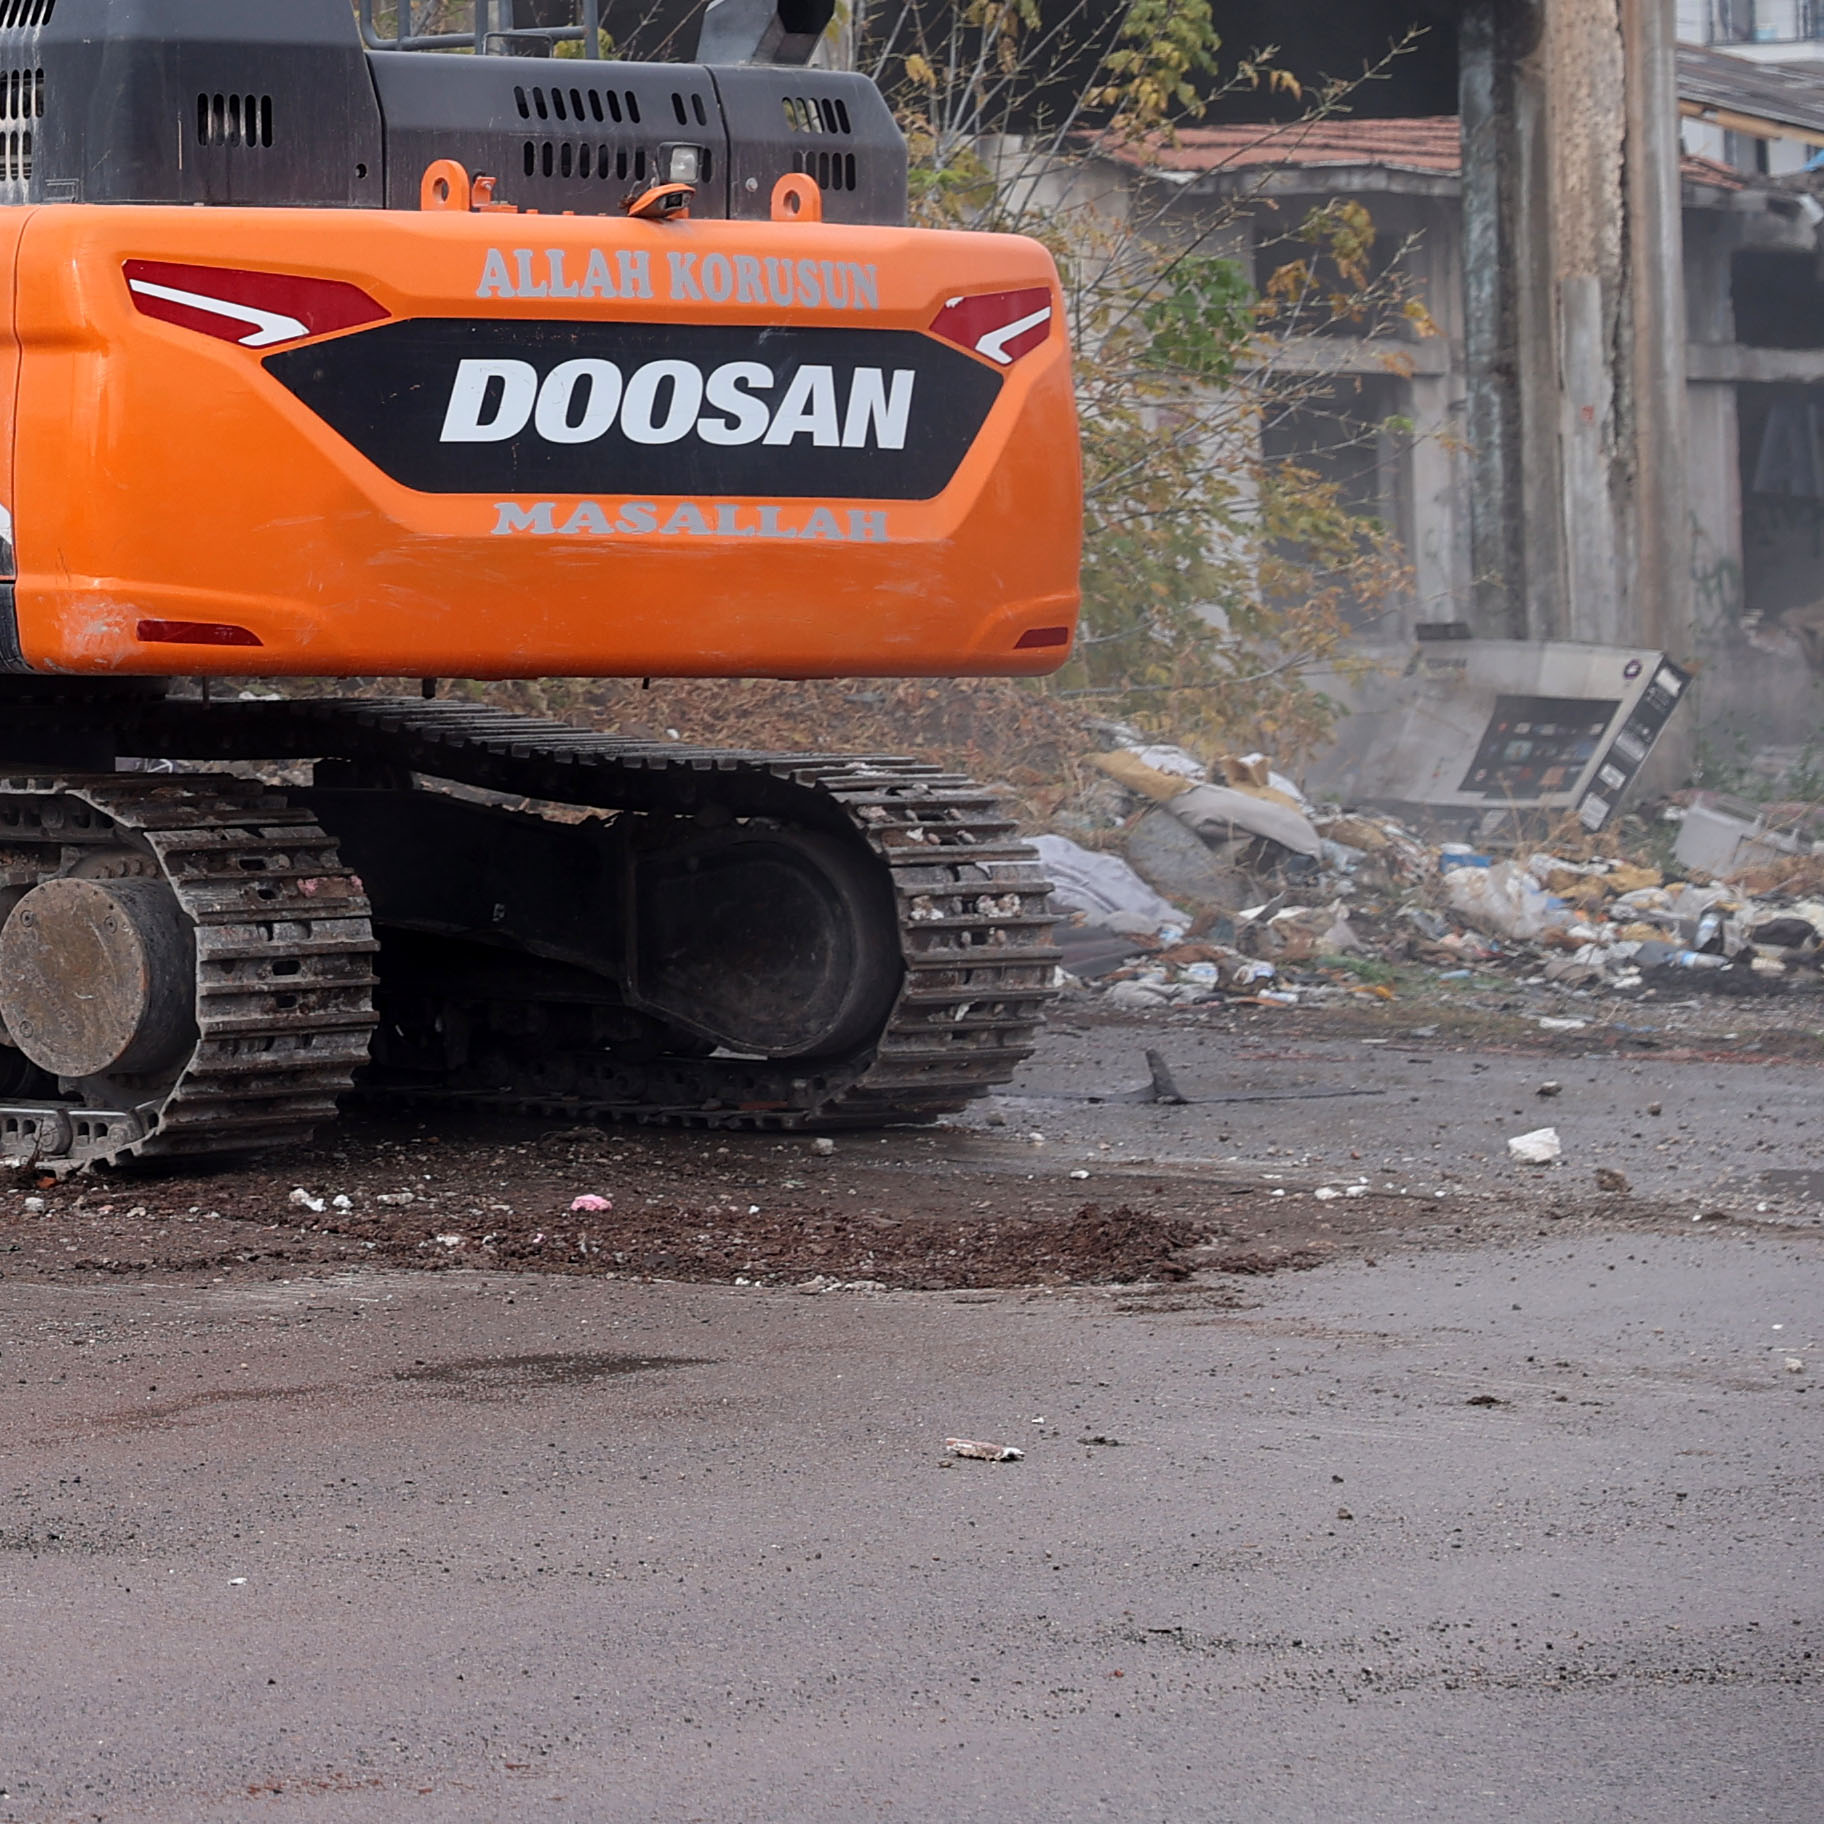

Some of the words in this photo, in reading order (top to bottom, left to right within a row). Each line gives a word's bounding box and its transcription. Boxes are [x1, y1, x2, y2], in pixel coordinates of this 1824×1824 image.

[476, 248, 654, 298] ALLAH
[667, 251, 879, 310] KORUSUN
[439, 358, 916, 450] DOOSAN
[490, 501, 890, 542] MASALLAH
